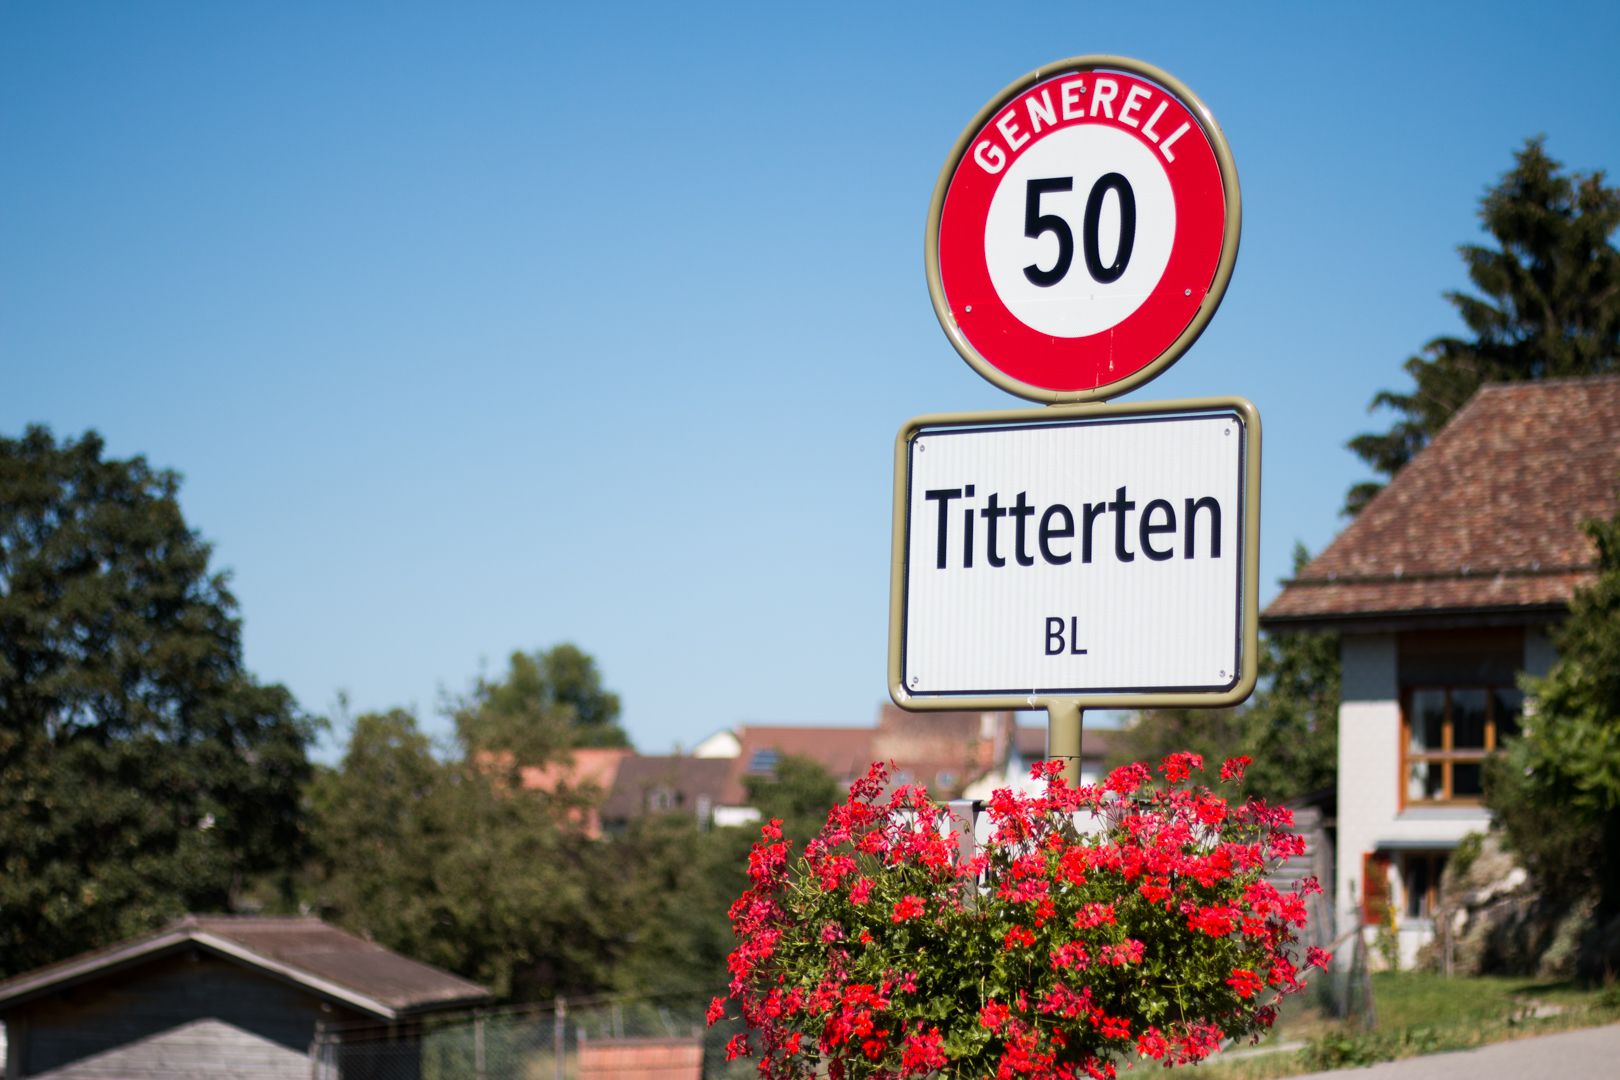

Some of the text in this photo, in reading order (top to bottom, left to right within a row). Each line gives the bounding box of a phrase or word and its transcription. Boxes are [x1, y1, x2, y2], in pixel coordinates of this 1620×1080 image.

[973, 78, 1190, 175] GENERELL
[1023, 172, 1137, 287] 50
[925, 484, 1222, 569] Titterten
[1044, 616, 1088, 655] BL
